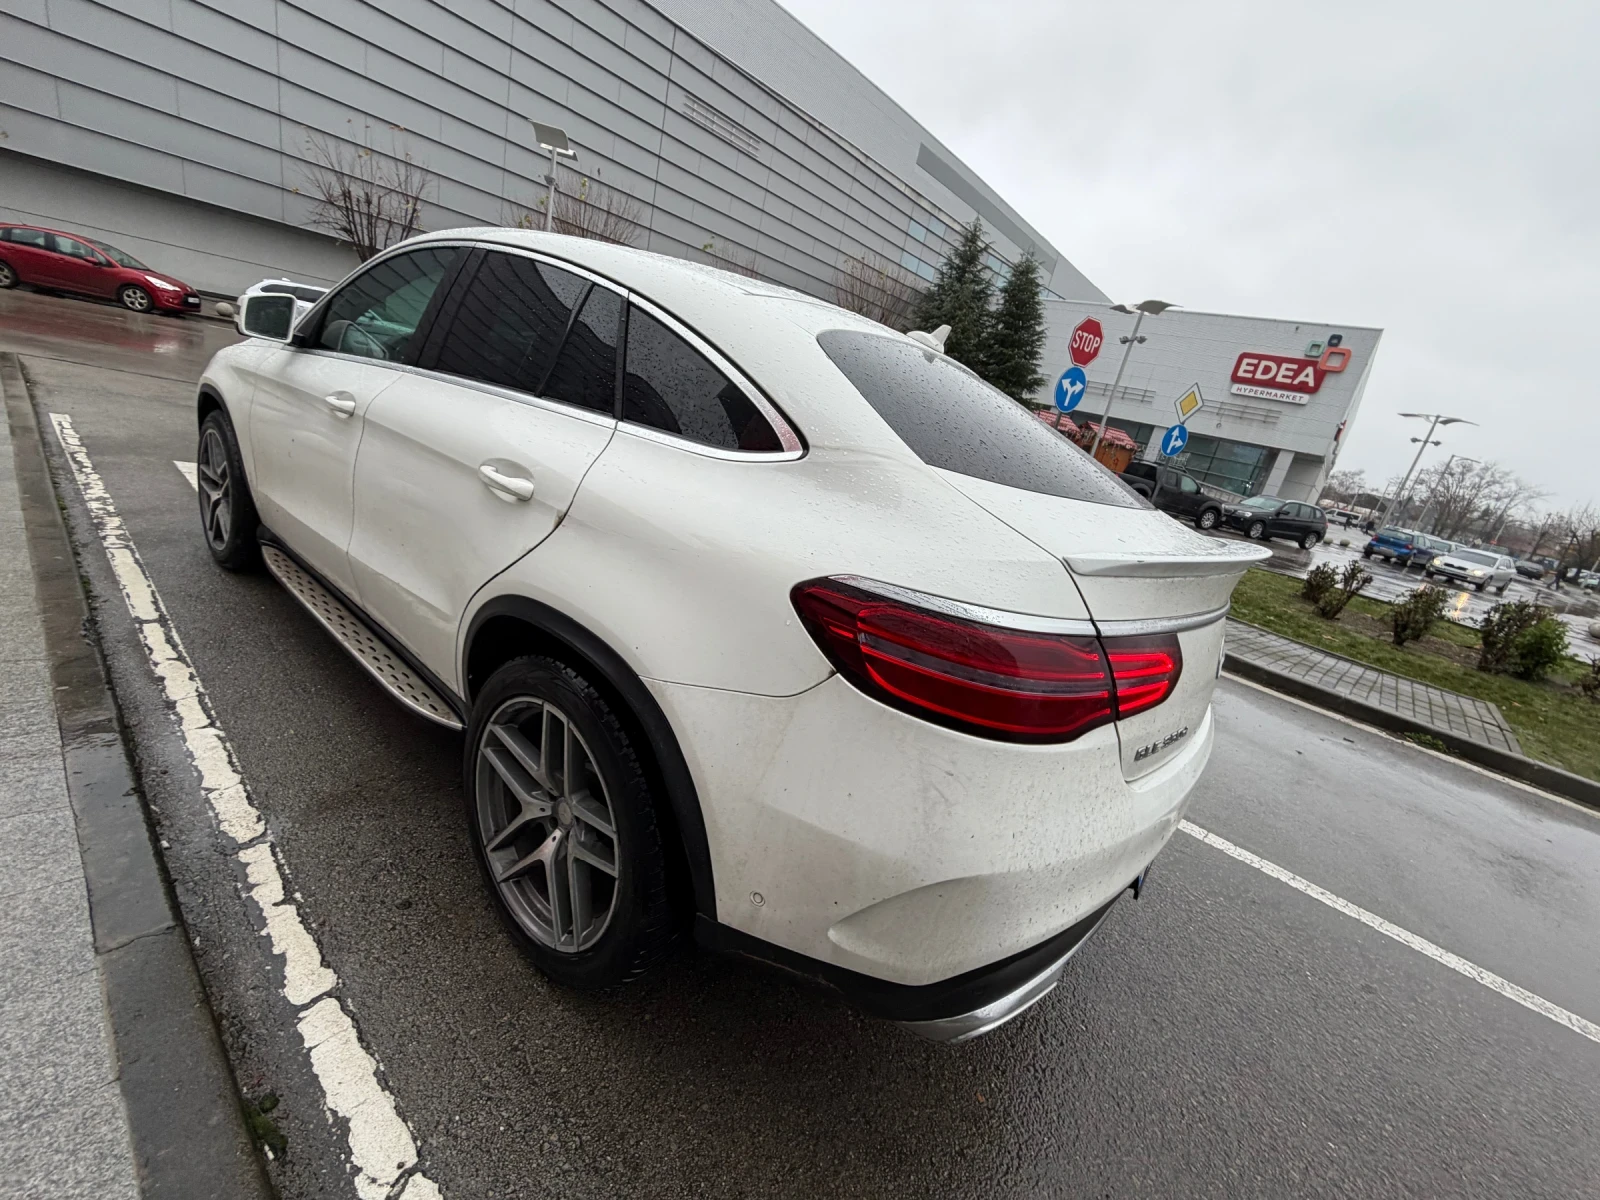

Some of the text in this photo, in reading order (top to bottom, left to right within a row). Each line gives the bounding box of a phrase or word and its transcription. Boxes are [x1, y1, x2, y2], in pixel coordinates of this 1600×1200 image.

[1073, 330, 1100, 354] STOP
[1237, 358, 1315, 387] EDEA
[1236, 386, 1304, 402] HYPERMARKET
